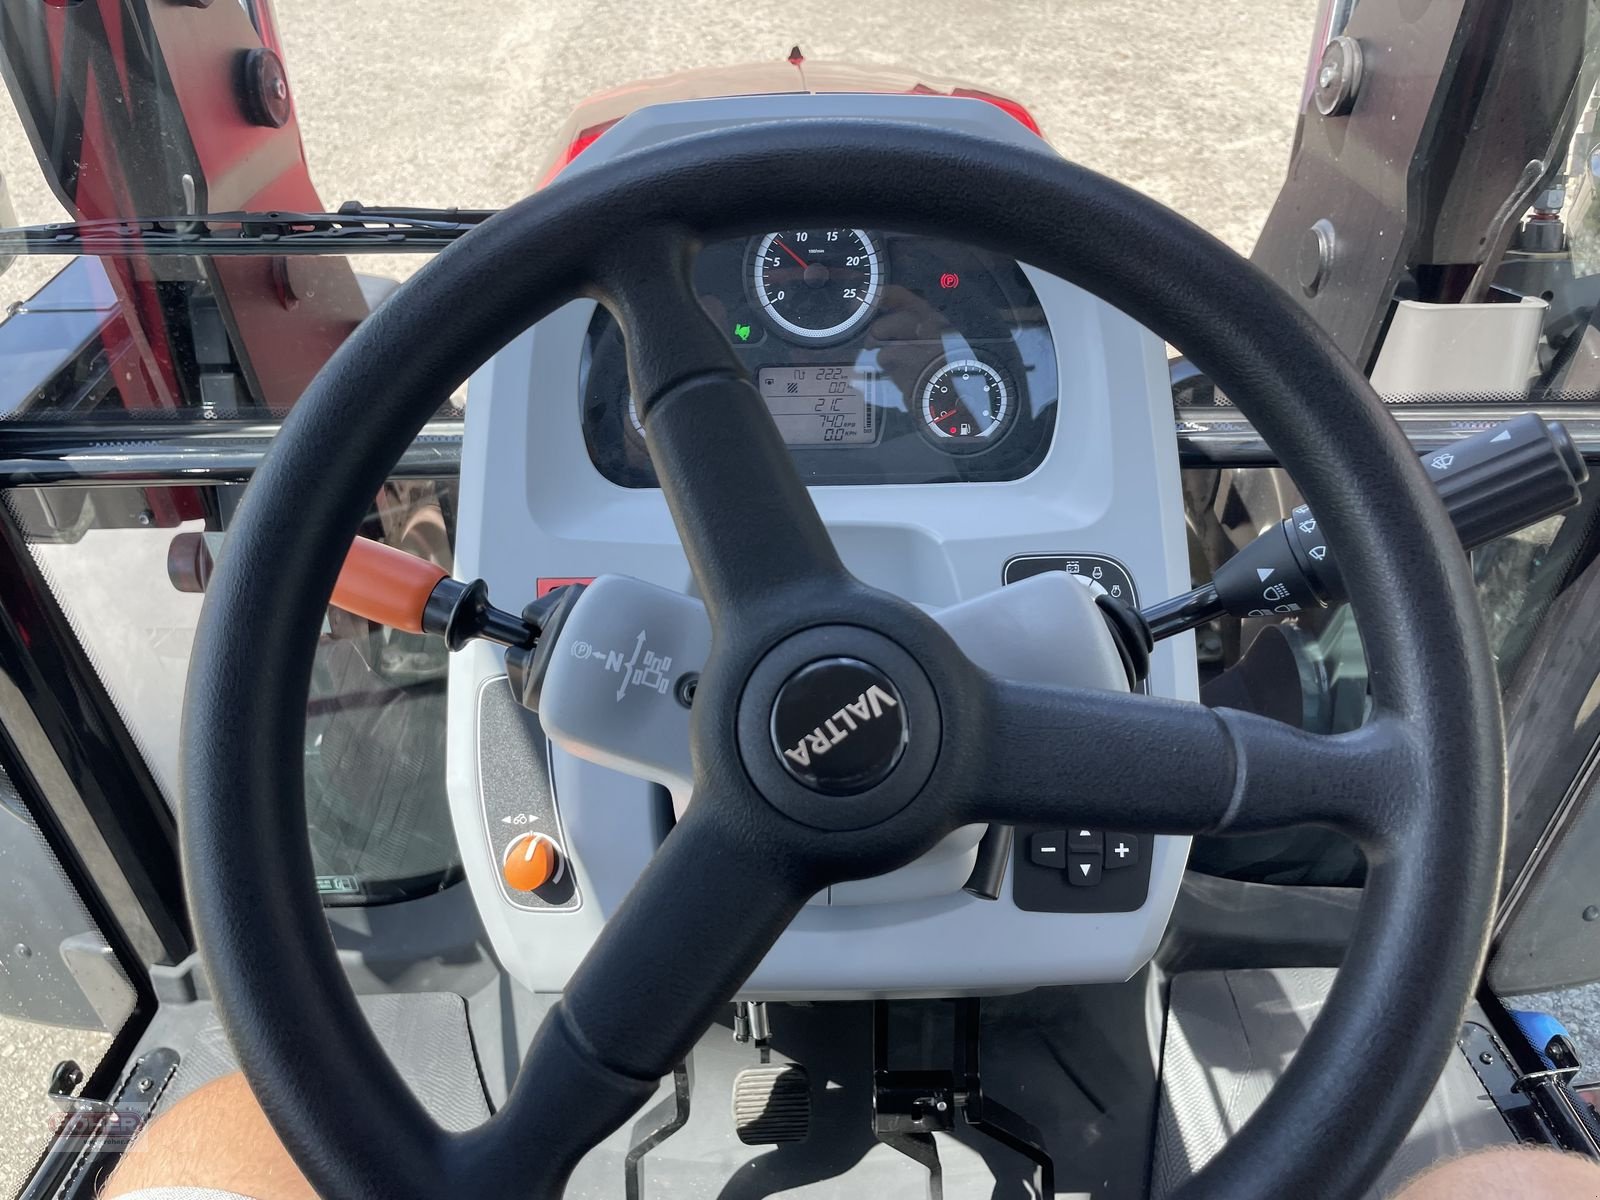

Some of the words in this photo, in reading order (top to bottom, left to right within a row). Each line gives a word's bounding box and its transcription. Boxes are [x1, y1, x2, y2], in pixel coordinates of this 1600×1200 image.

[795, 232, 808, 241] 10
[826, 231, 839, 241] 15
[773, 257, 780, 267] 5
[845, 256, 860, 266] 20
[777, 291, 785, 300] 0
[843, 288, 857, 298] 25
[819, 414, 845, 428] 740
[604, 649, 625, 673] N
[784, 684, 897, 766] VALTRA
